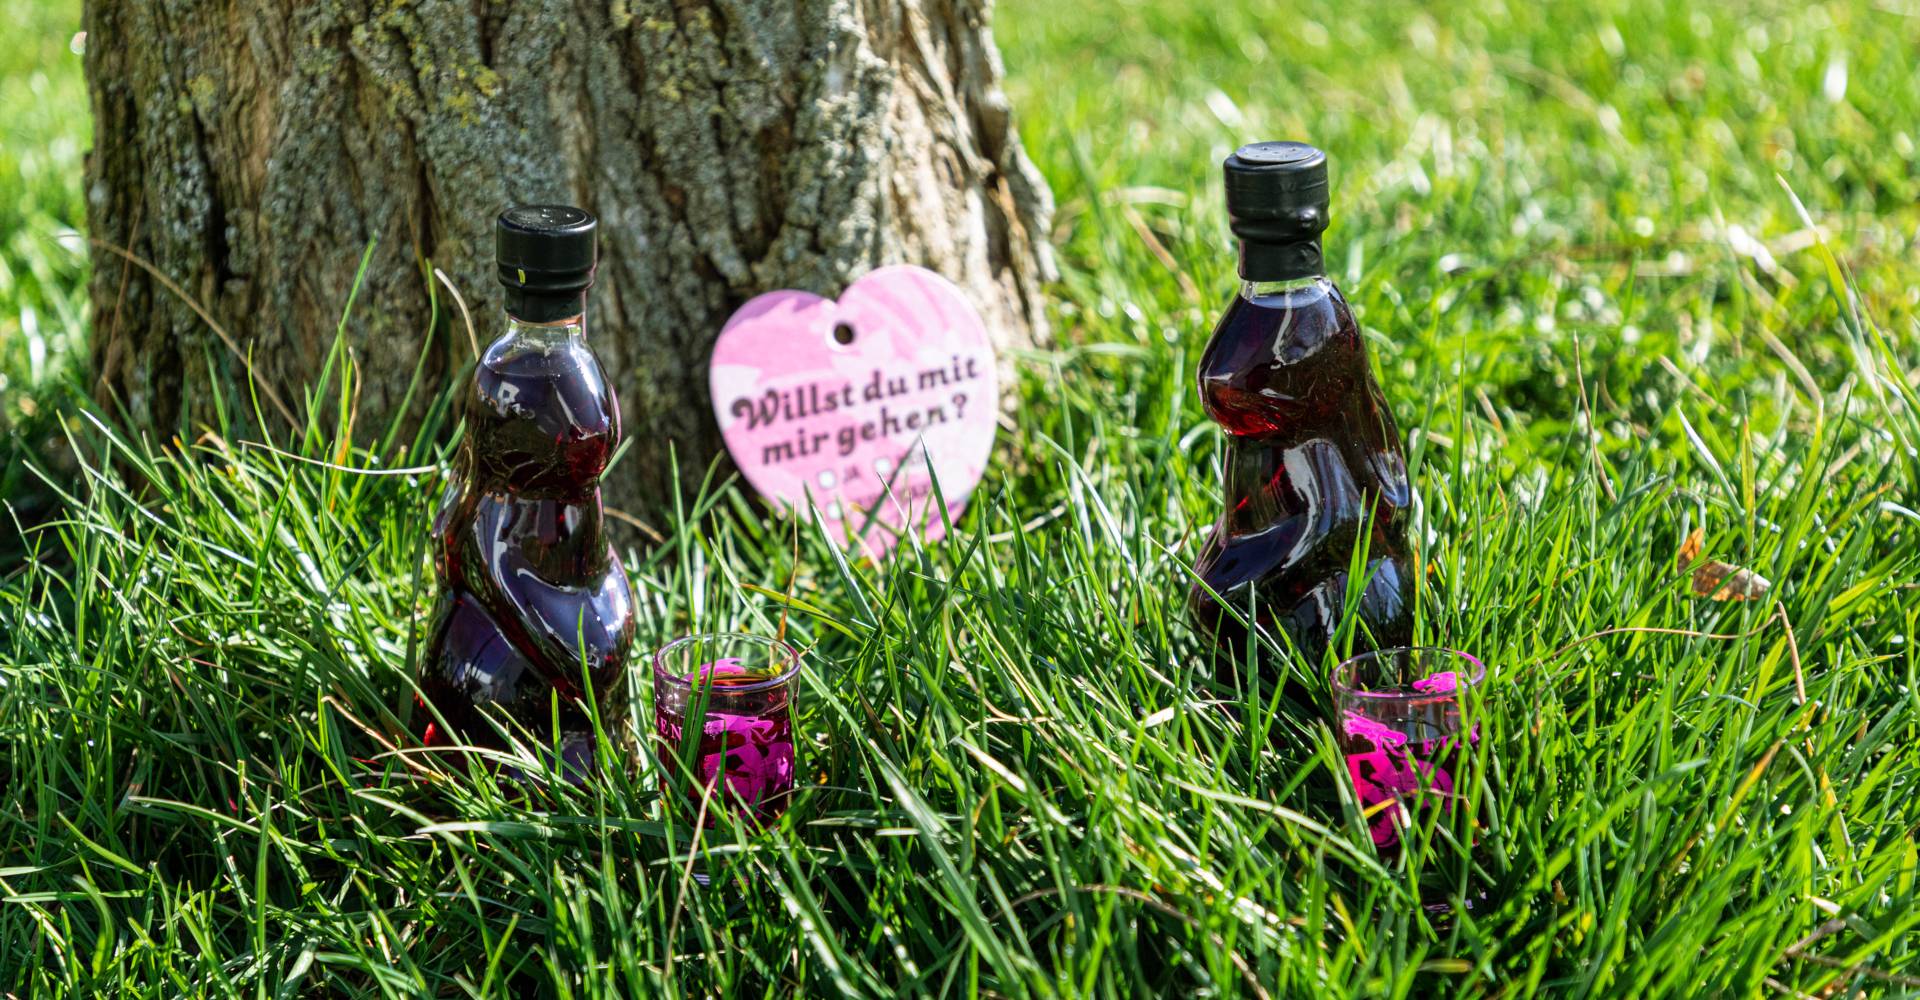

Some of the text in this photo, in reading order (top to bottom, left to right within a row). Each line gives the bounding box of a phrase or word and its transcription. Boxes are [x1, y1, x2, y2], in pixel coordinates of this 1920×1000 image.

[730, 355, 980, 431] Willst du mit
[761, 393, 969, 465] mir gehen?
